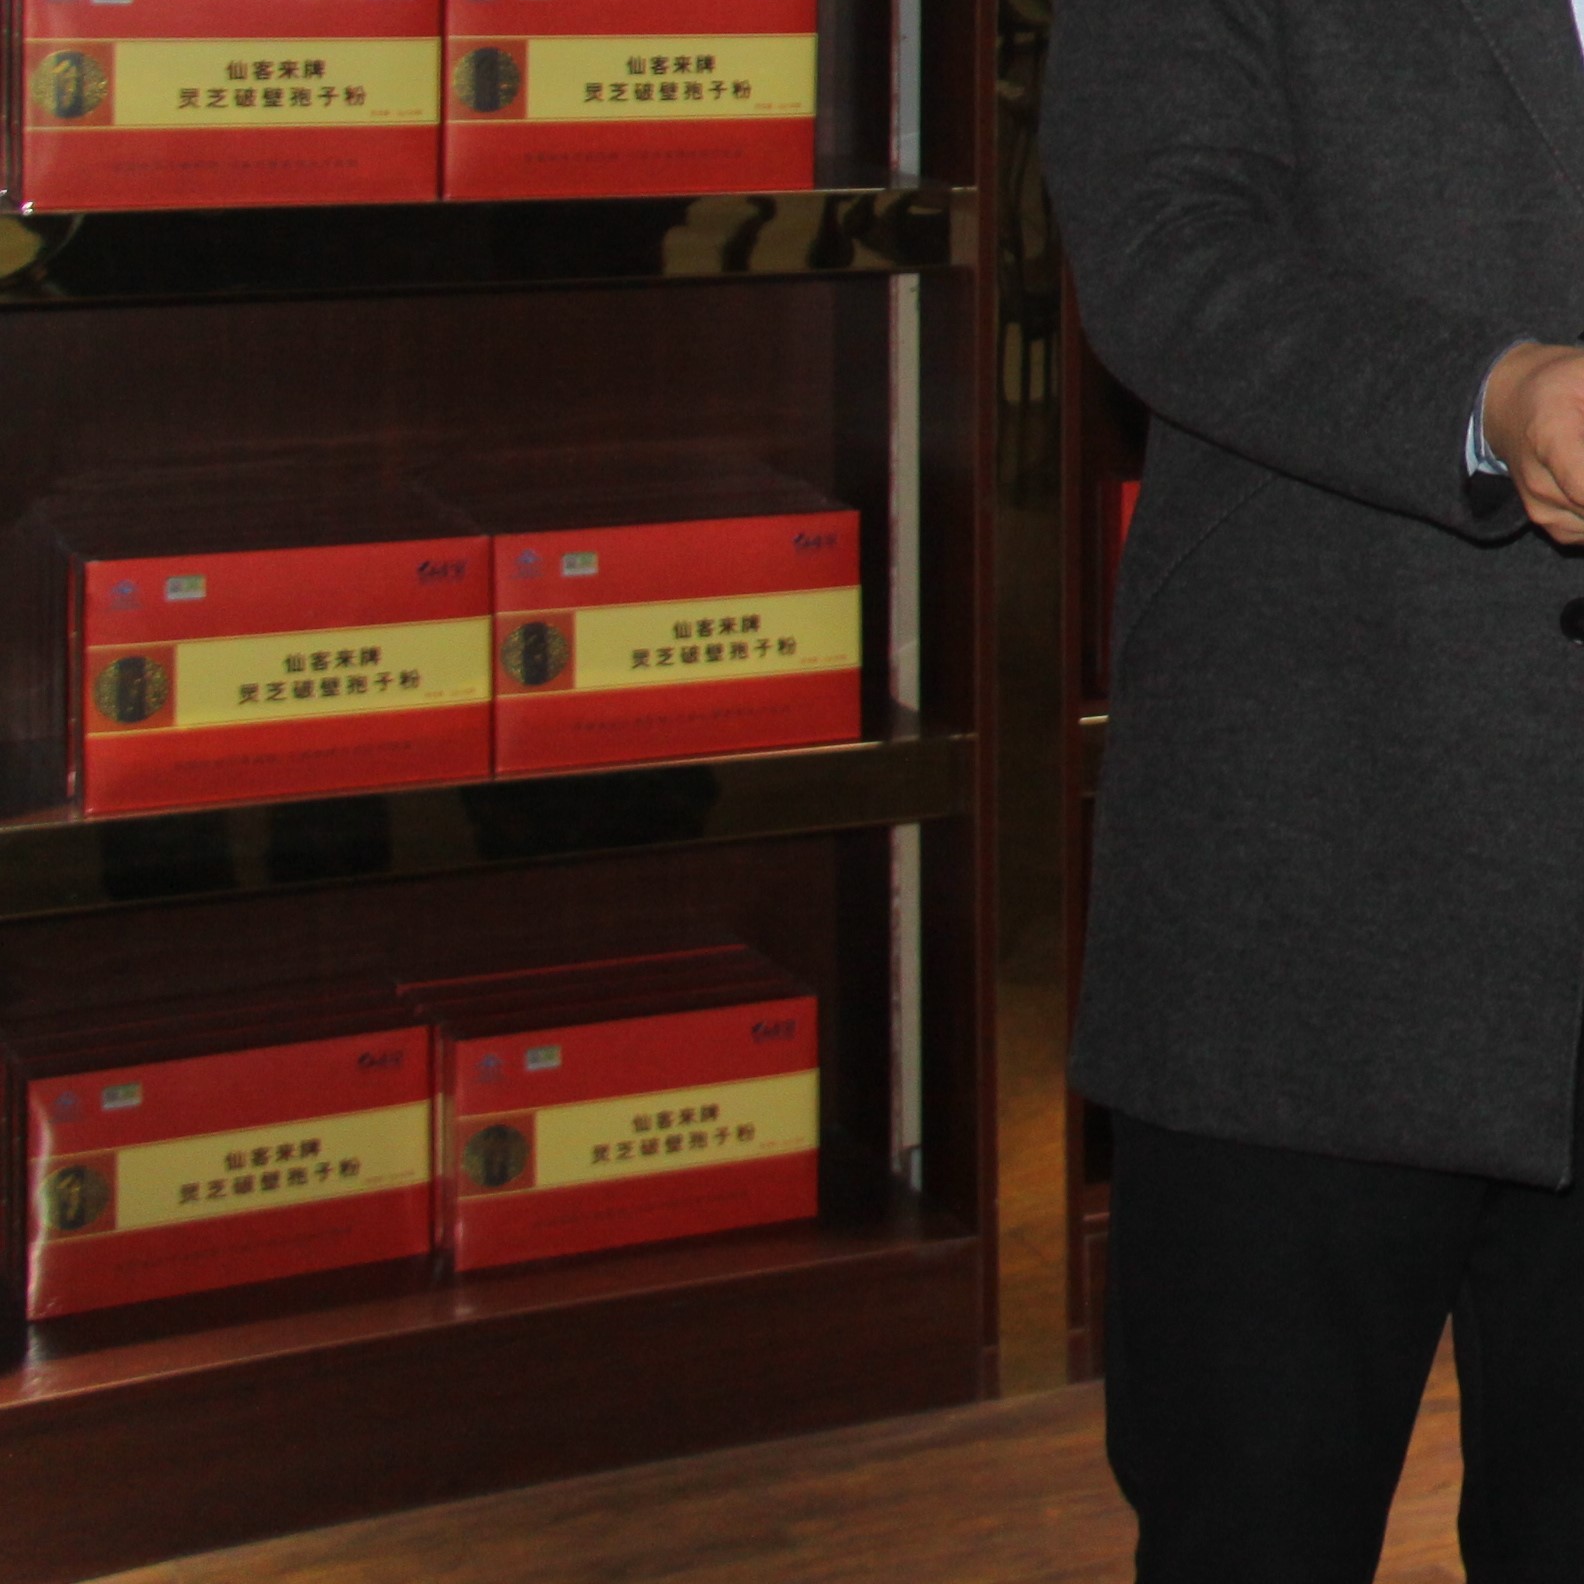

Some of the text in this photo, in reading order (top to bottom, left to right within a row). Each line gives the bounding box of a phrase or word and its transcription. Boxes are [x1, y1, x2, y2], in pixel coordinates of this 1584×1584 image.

[226, 59, 326, 80] 仙客来牌
[627, 55, 716, 75] 仙客来牌
[178, 85, 367, 109] 灵芝破壁孢子粉
[584, 80, 751, 103] 灵芝破壁孢子粉
[673, 614, 761, 639] 仙客来牌
[284, 647, 382, 673] 仙客来牌
[632, 637, 797, 669] 灵芝破壁孢子粉
[240, 670, 421, 704] 灵芝破壁孢子粉
